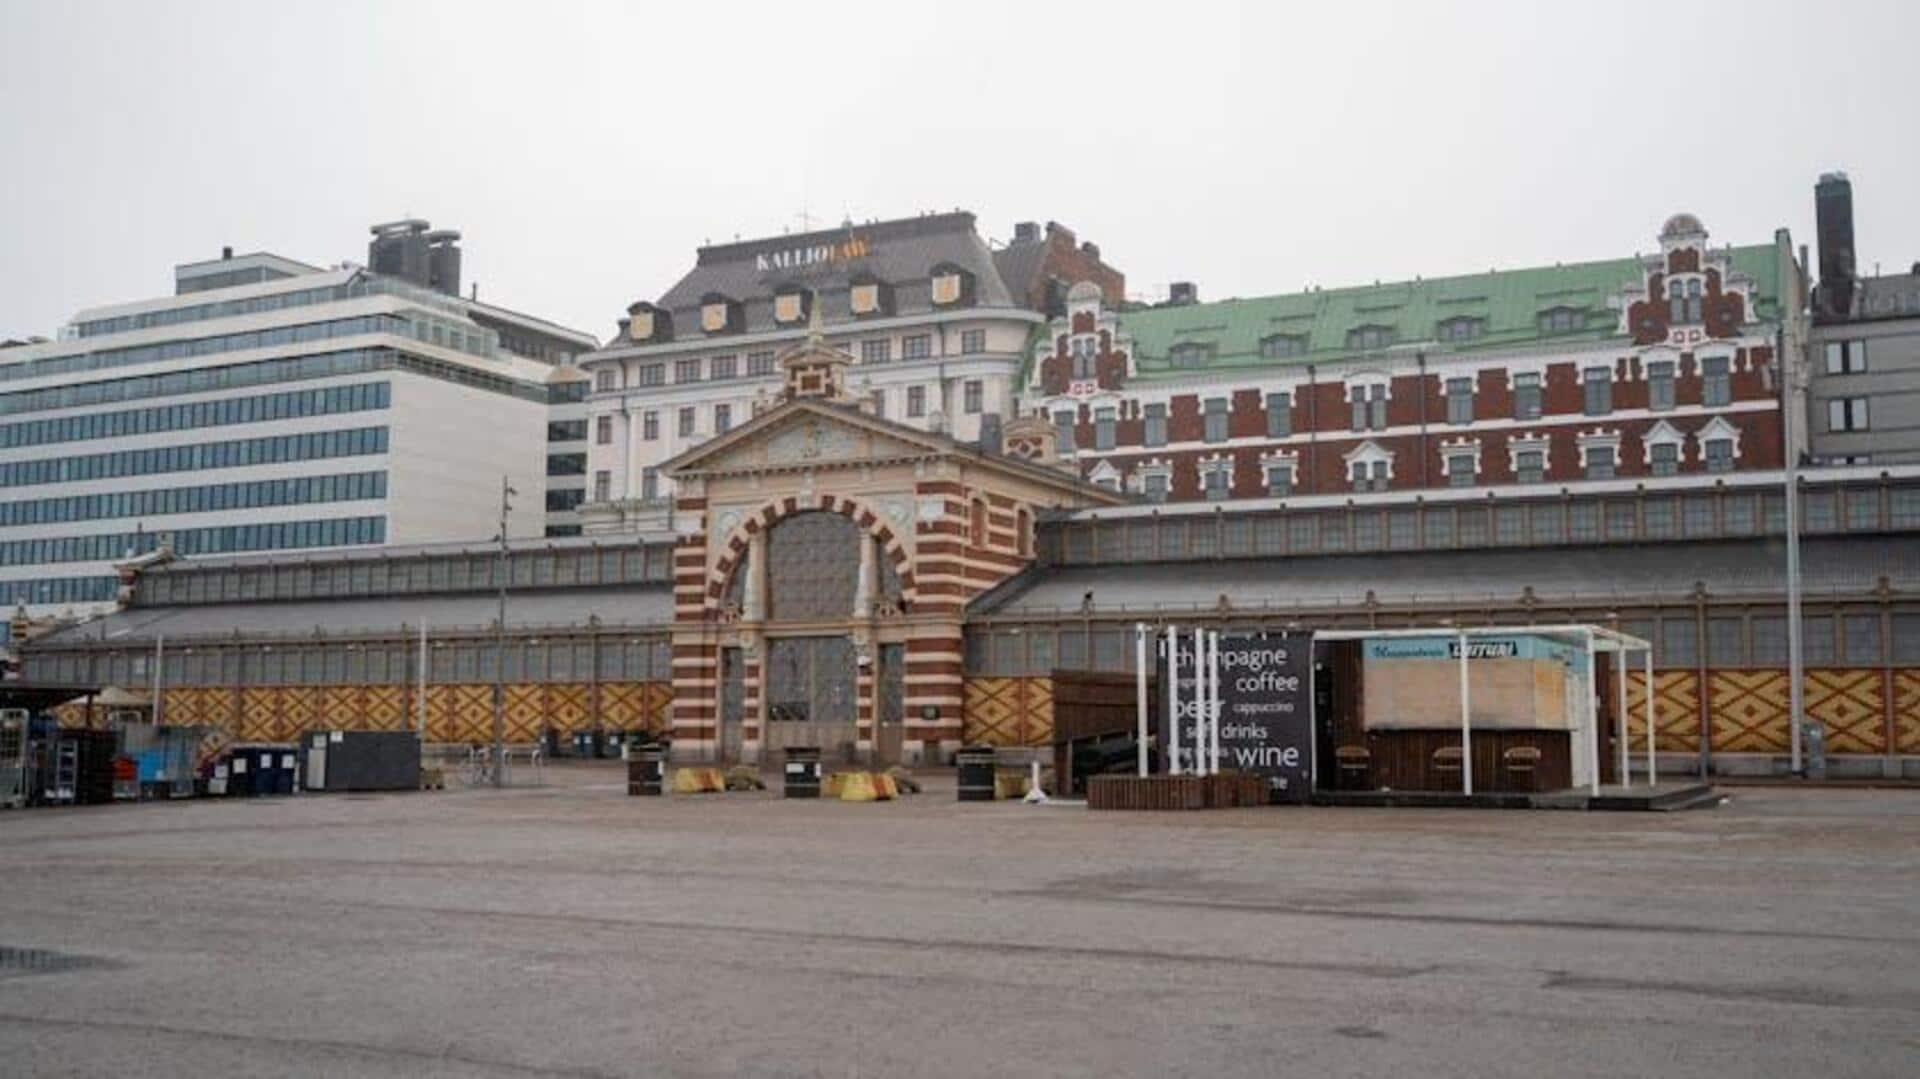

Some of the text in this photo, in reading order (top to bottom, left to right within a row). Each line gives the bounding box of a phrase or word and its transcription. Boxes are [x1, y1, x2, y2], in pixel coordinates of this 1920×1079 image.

[1174, 646, 1287, 670] hmpagne
[1236, 671, 1299, 691] coffee
[1232, 703, 1294, 715] cappuccino
[1221, 722, 1268, 740] drinks
[1235, 742, 1299, 767] wine
